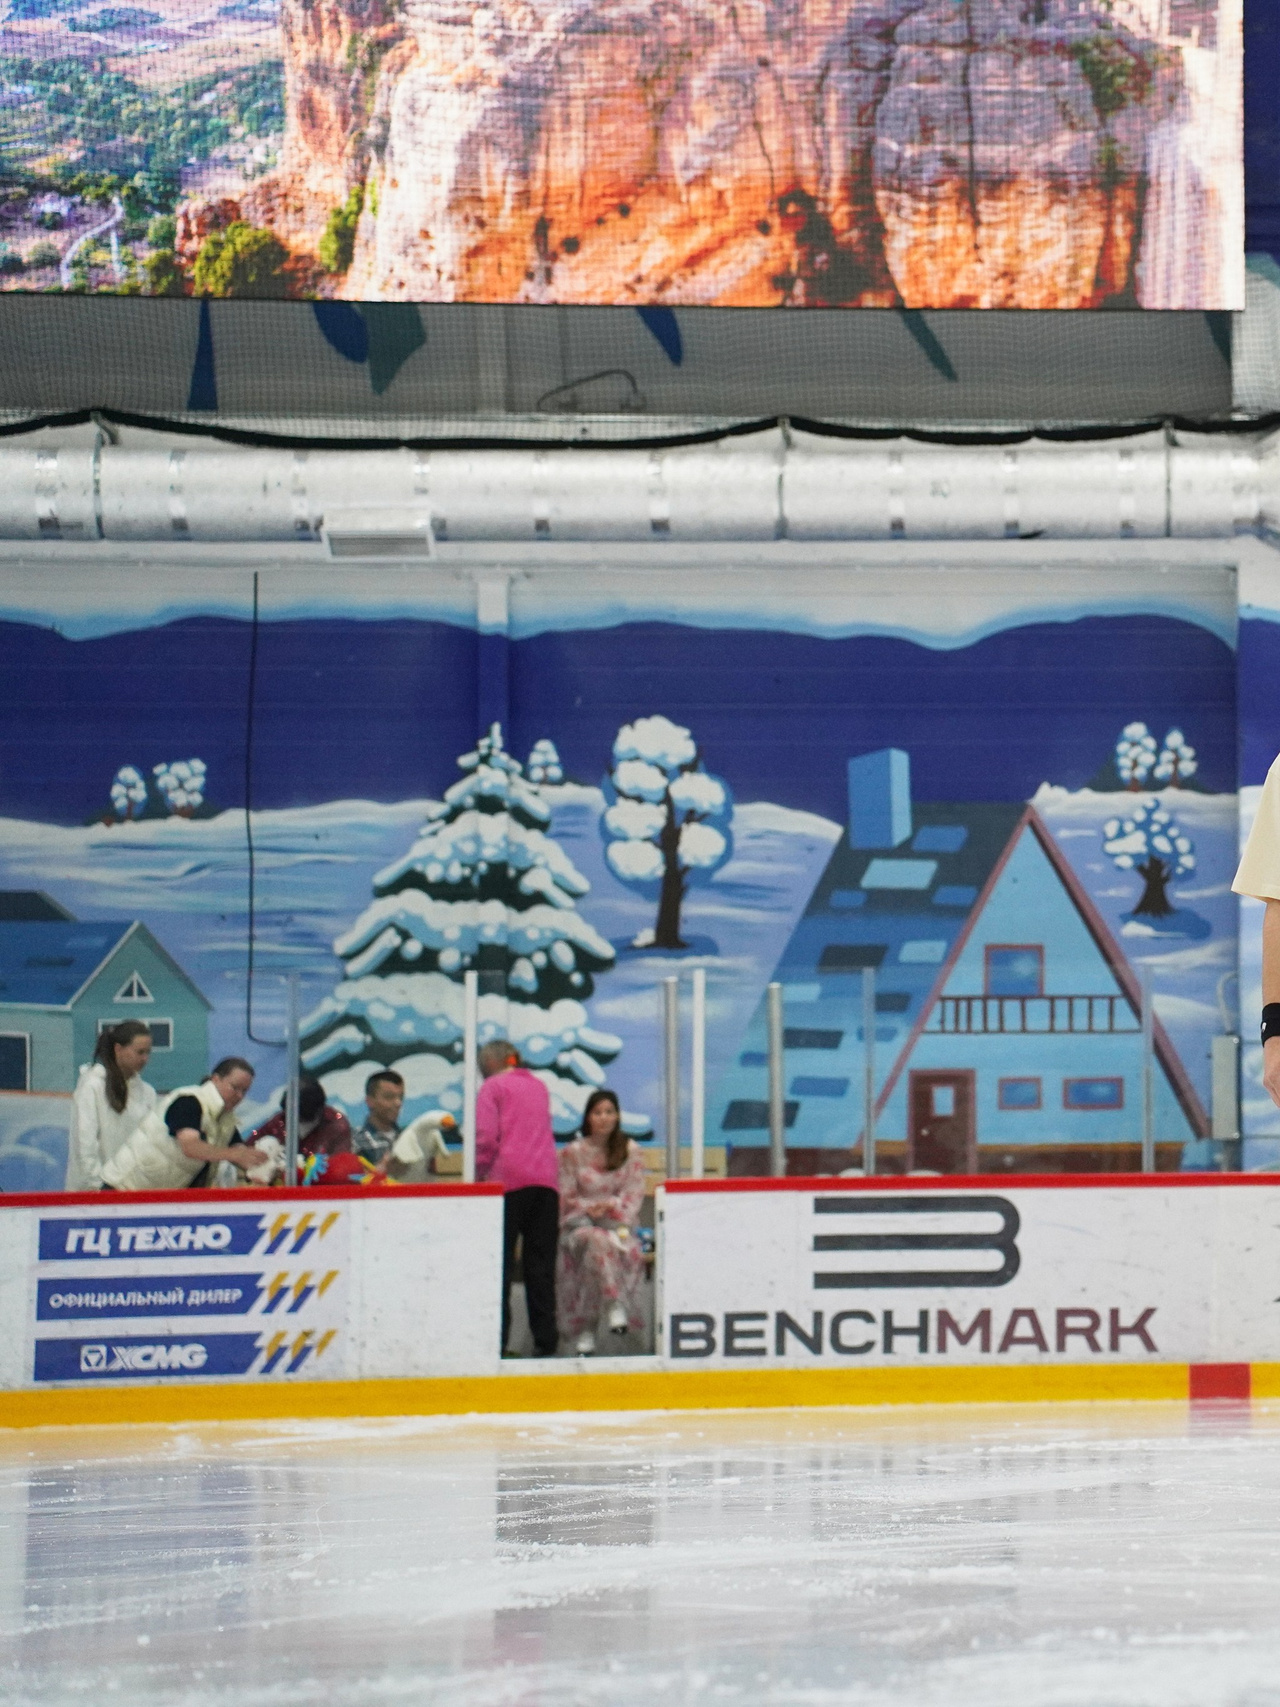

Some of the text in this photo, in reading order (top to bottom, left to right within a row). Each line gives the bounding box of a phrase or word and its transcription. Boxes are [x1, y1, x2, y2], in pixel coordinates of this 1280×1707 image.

[65, 1222, 233, 1257] ГЦ ТЕХНО
[49, 1286, 244, 1310] ОФИЦИАЛЬНЫЙ ДИЛЕР
[668, 1306, 1159, 1359] BENCHMARK
[111, 1342, 209, 1371] XCMG
